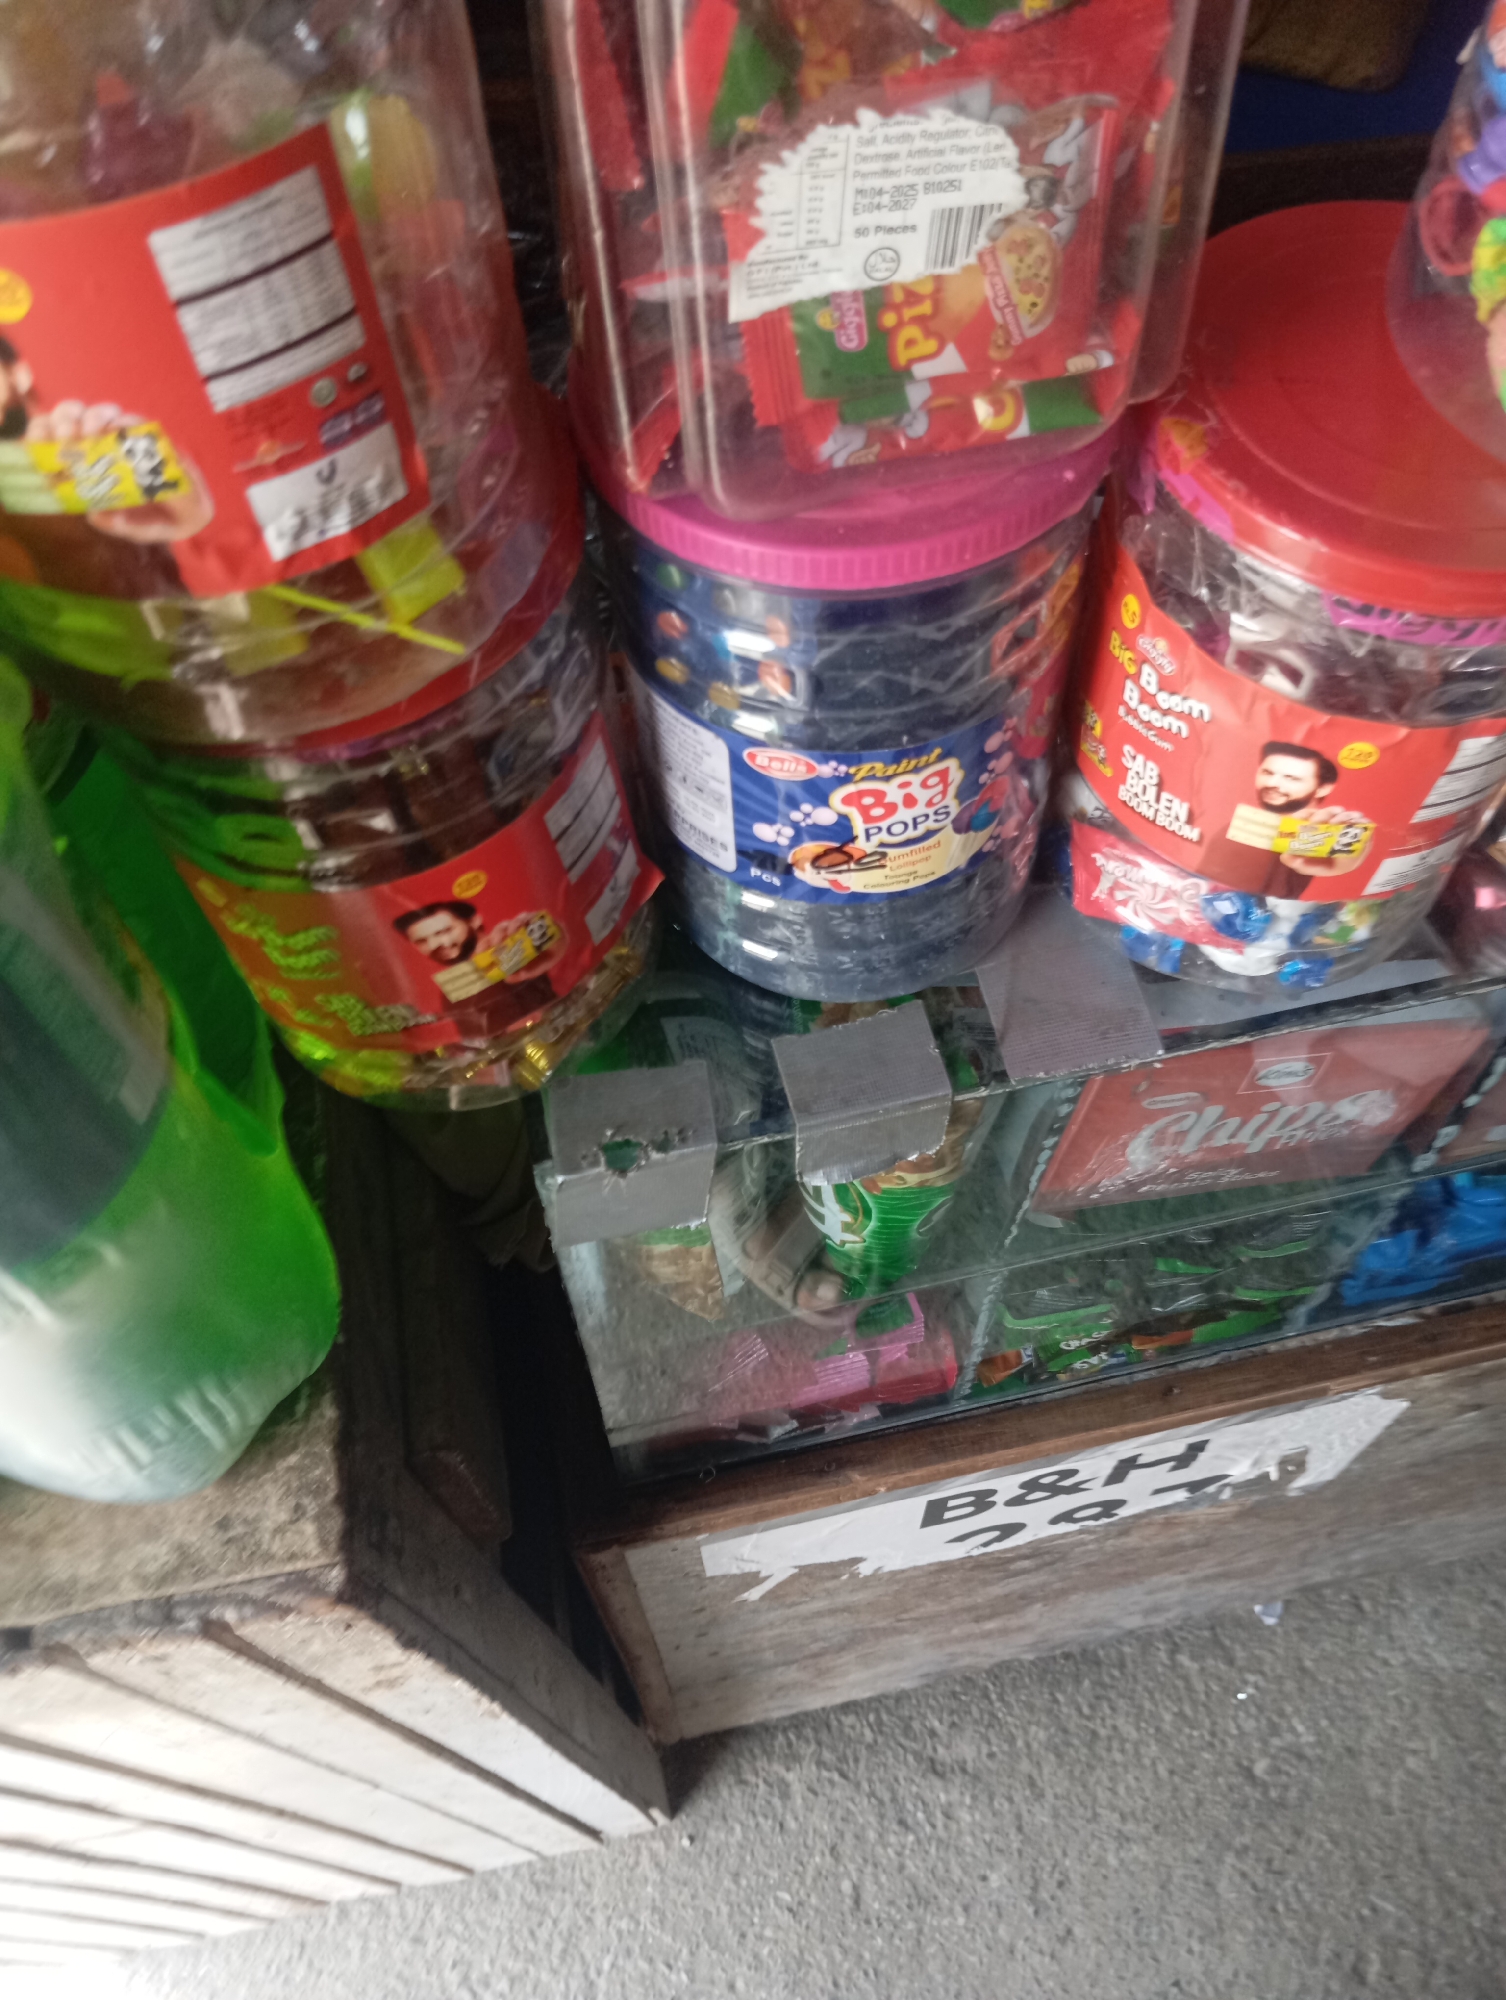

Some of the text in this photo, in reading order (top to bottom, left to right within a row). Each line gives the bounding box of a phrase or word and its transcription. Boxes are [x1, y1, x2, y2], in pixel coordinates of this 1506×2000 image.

[852, 169, 901, 182] Permitted
[904, 164, 931, 177] Food
[933, 162, 967, 176] Colour
[905, 146, 946, 161] Artificial
[949, 143, 981, 157] Flavor
[854, 224, 918, 239] 50 Pieces
[1122, 678, 1189, 739] Boom
[1139, 661, 1211, 723] Boom
[849, 747, 943, 783] Paint
[1120, 743, 1161, 787] SAB
[840, 766, 951, 826] Big
[1118, 784, 1201, 843] BOOM BOOM
[1126, 771, 1192, 825] BOLEN
[864, 805, 951, 843] POPS
[920, 1439, 1211, 1529] B&H
